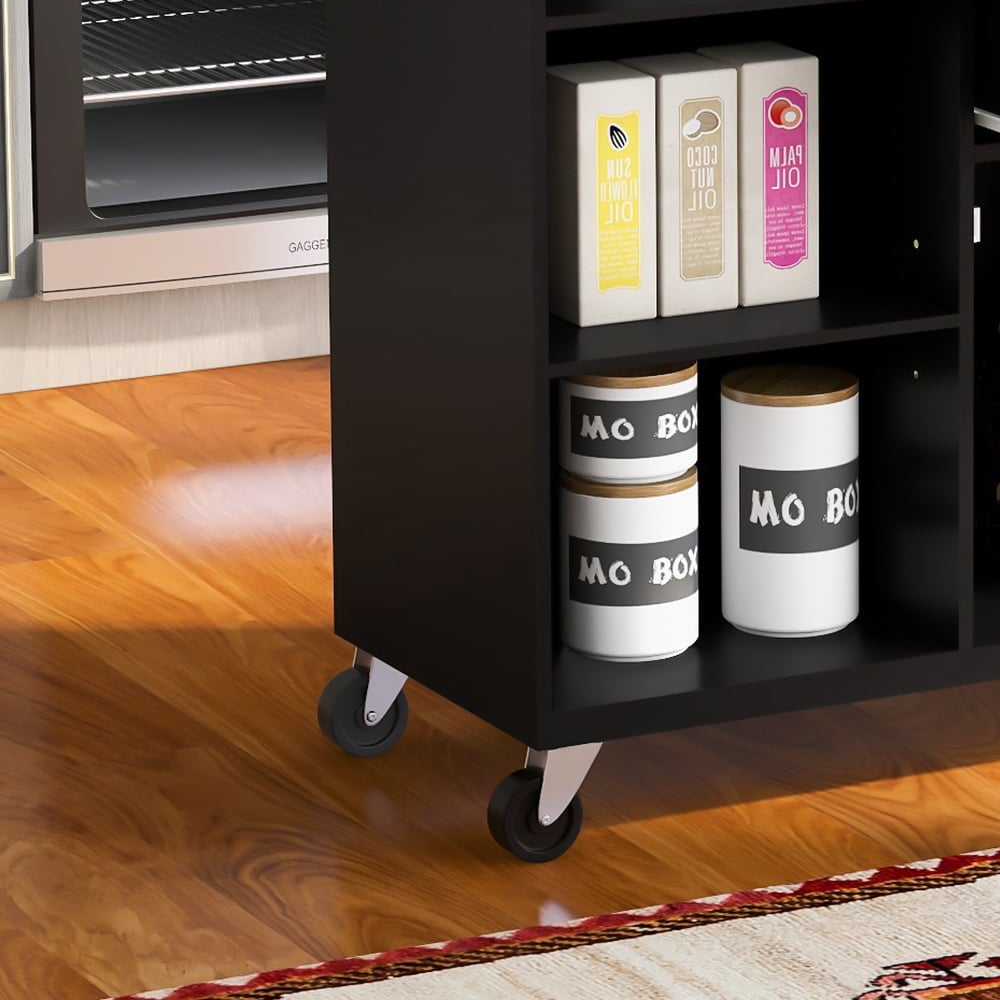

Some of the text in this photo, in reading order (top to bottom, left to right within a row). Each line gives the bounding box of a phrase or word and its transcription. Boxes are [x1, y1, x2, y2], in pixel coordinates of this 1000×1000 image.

[580, 415, 635, 441] MO
[750, 489, 805, 527] MO
[578, 546, 698, 586] MO BOX
